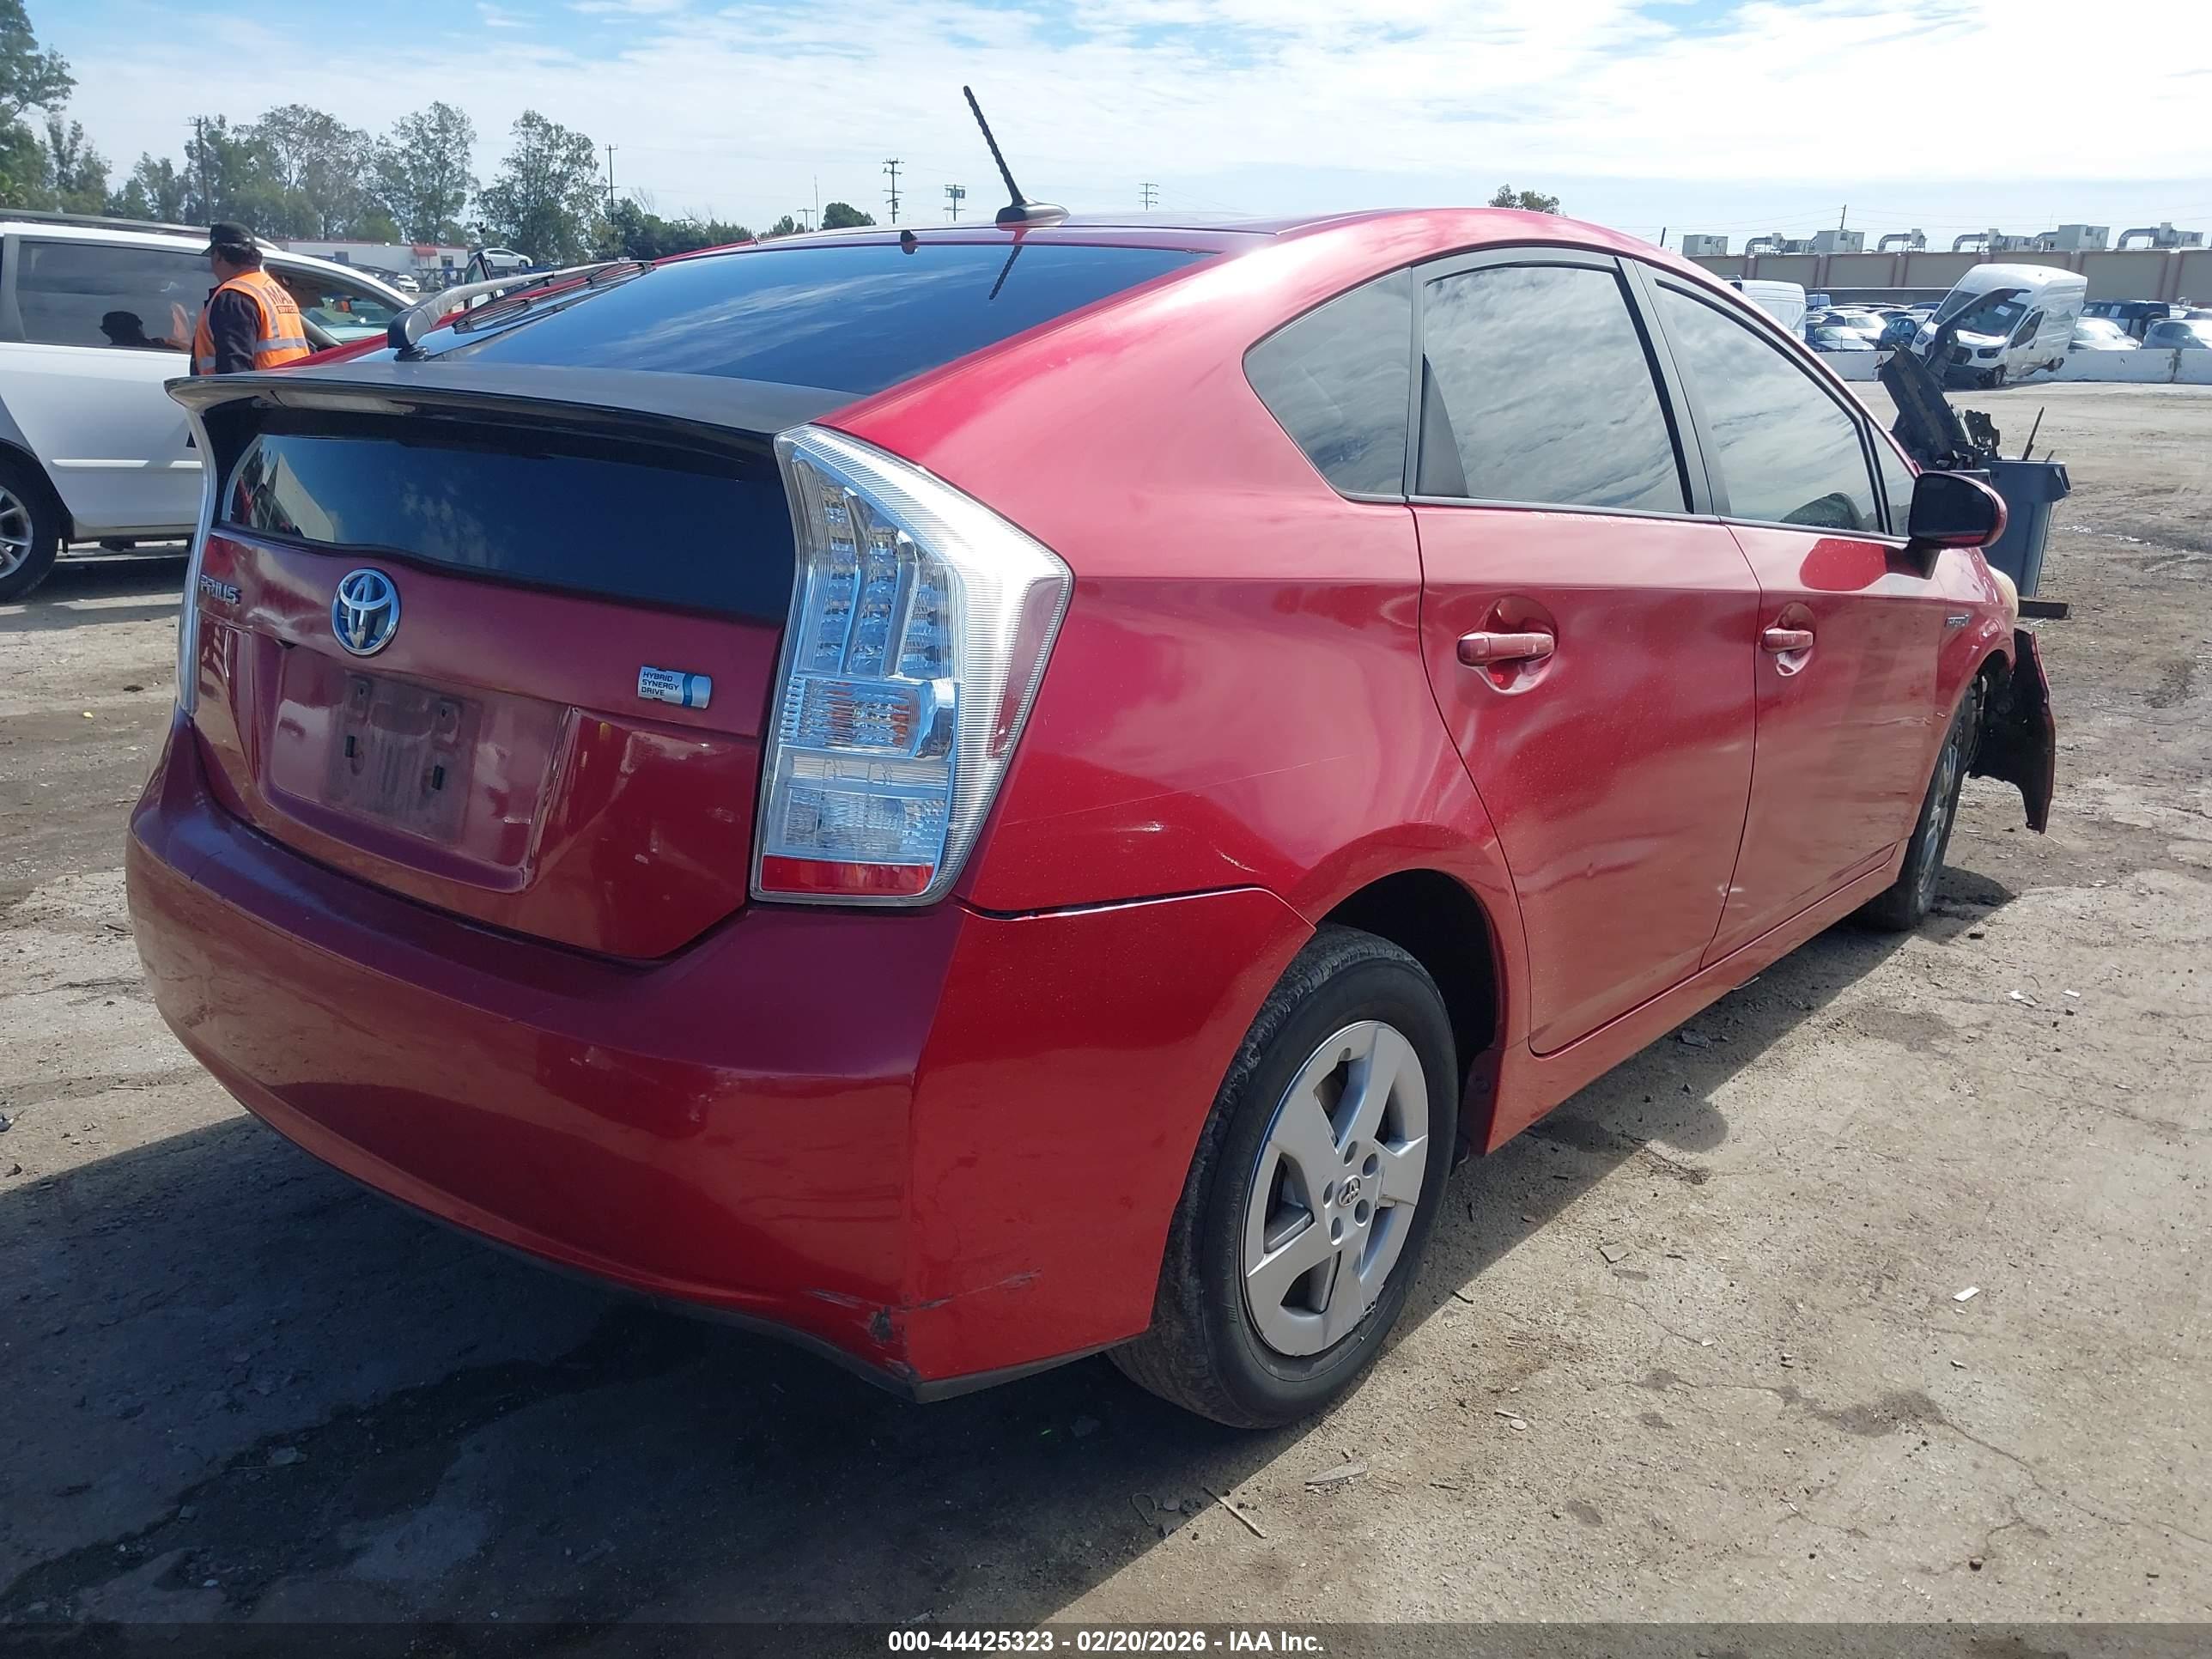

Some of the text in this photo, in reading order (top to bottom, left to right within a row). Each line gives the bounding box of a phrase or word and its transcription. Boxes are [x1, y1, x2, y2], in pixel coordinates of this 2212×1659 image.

[200, 574, 239, 605] PRIUS
[642, 672, 674, 683] HYBRID
[641, 679, 679, 690] SYNERGY
[641, 687, 665, 696] DRIVE
